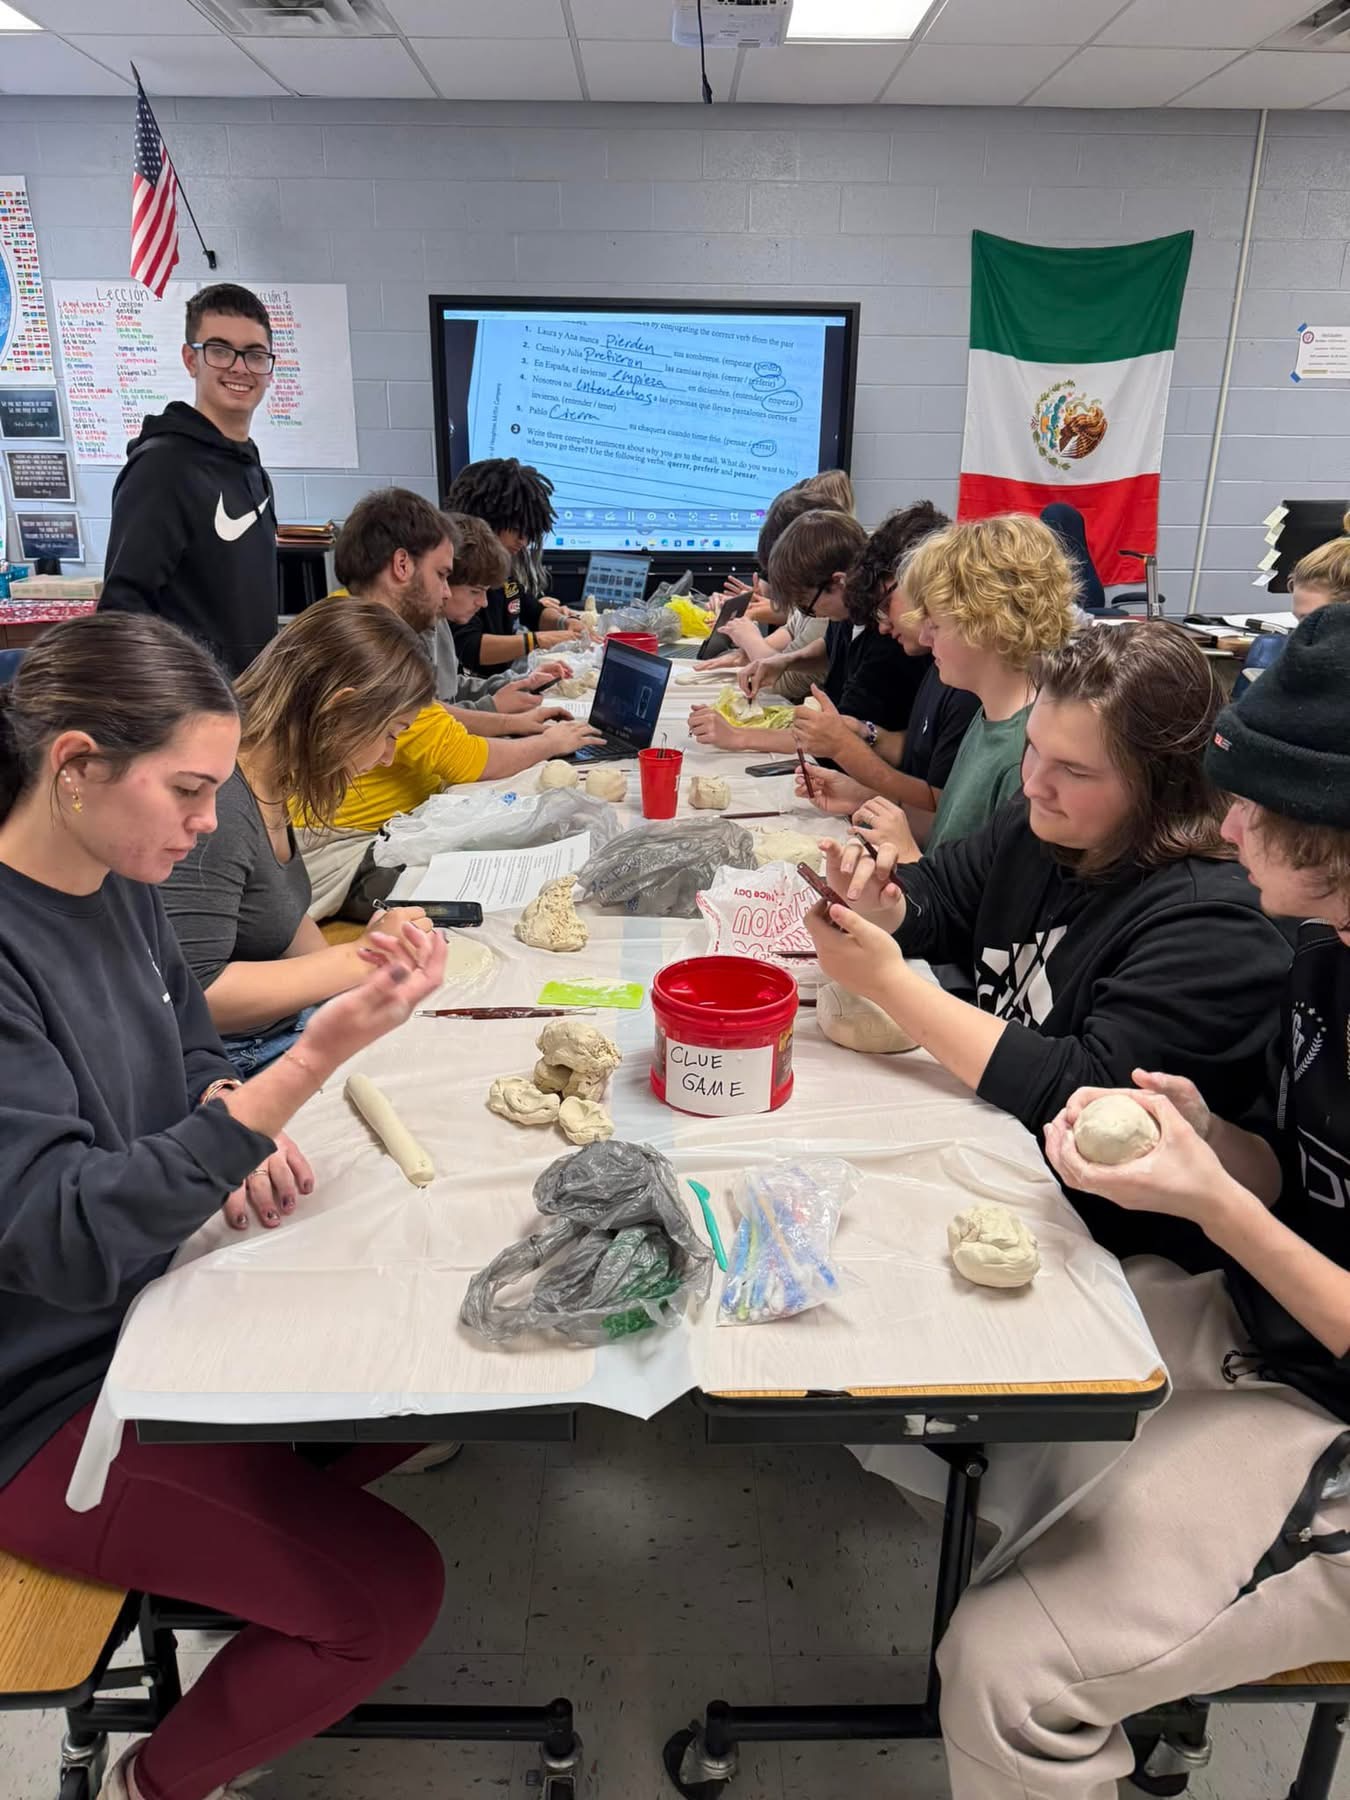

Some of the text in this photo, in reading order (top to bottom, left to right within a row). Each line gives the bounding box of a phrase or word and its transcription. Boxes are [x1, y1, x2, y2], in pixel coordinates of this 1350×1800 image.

[96, 285, 149, 302] Lección
[283, 291, 291, 304] 2
[537, 327, 557, 337] Laura
[565, 332, 578, 341] Ana
[579, 335, 600, 344] nunca
[660, 322, 699, 335] conjugating
[711, 330, 735, 340] correct
[735, 333, 750, 342] verb
[751, 335, 768, 344] from
[769, 338, 779, 346] the
[534, 359, 543, 367] En
[572, 364, 579, 372] el
[580, 366, 607, 378] invierno
[535, 343, 560, 354] Camila
[664, 364, 674, 374] las
[675, 366, 701, 376] camisas
[532, 375, 562, 387] Nosotros
[659, 395, 669, 404] las
[669, 397, 698, 409] personas
[732, 405, 767, 419] pantalones
[529, 405, 548, 417] Pablo
[638, 424, 666, 436] chaqueta
[667, 429, 691, 438] cuando
[527, 427, 546, 438] Write
[547, 431, 563, 441] three
[564, 433, 594, 448] complete
[627, 442, 645, 452] about
[646, 447, 659, 458] why
[660, 450, 673, 459] you
[674, 452, 683, 460] go
[691, 453, 702, 462] the
[720, 457, 738, 467] What
[739, 460, 748, 468] do
[749, 464, 761, 473] you
[762, 464, 778, 473] want
[527, 438, 544, 448] when
[545, 442, 558, 452] you
[559, 444, 568, 452] go
[569, 443, 588, 454] there?
[590, 447, 603, 456] Use
[604, 448, 614, 457] the
[615, 450, 646, 464] following
[667, 461, 692, 472] querer,
[693, 464, 720, 475] preferir
[721, 468, 733, 476] and
[734, 470, 759, 481] pensar.
[734, 887, 752, 900] Day
[670, 1046, 723, 1069] CLUE
[682, 1073, 744, 1097] GAME
